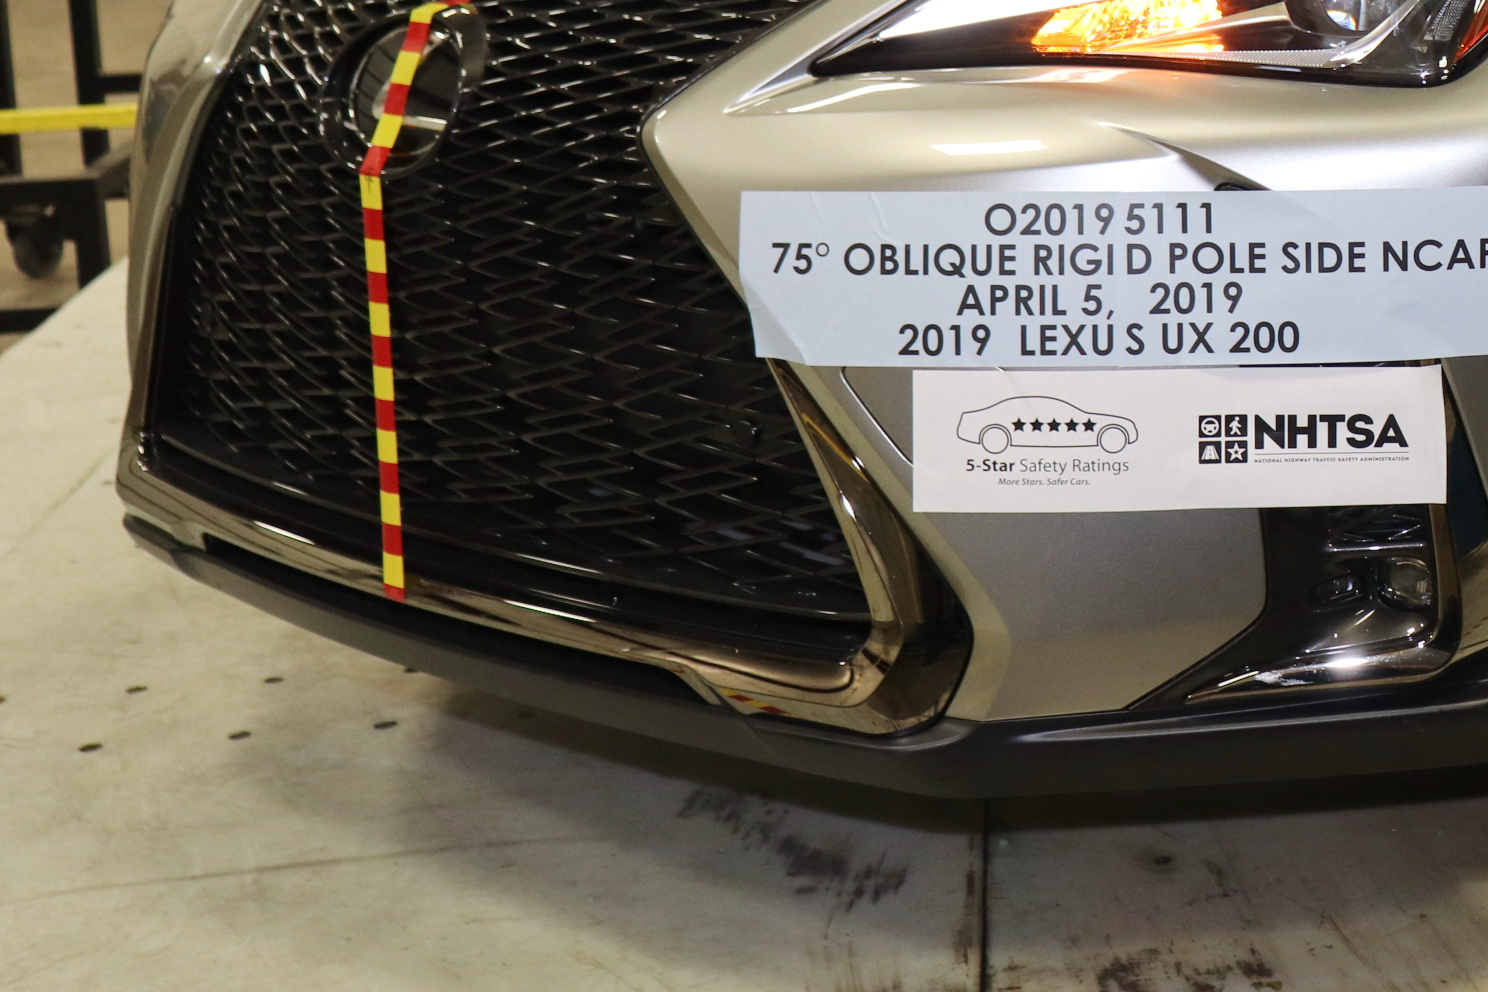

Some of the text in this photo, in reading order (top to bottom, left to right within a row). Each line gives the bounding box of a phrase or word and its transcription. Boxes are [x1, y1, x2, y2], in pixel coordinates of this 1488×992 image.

[843, 243, 1018, 279] OBLIQUE
[1033, 242, 1152, 277] RIGID
[1168, 241, 1267, 275] POLE
[1280, 241, 1366, 275] SIDE
[955, 281, 1243, 321] APRIL 5, 2019
[898, 320, 1301, 357] 2019 LEXUS UX 200
[1253, 412, 1410, 450] NHTSA
[966, 458, 1130, 476] 5-Star Safety Ratings
[997, 477, 1091, 486] More Stars. Safer Cars.
